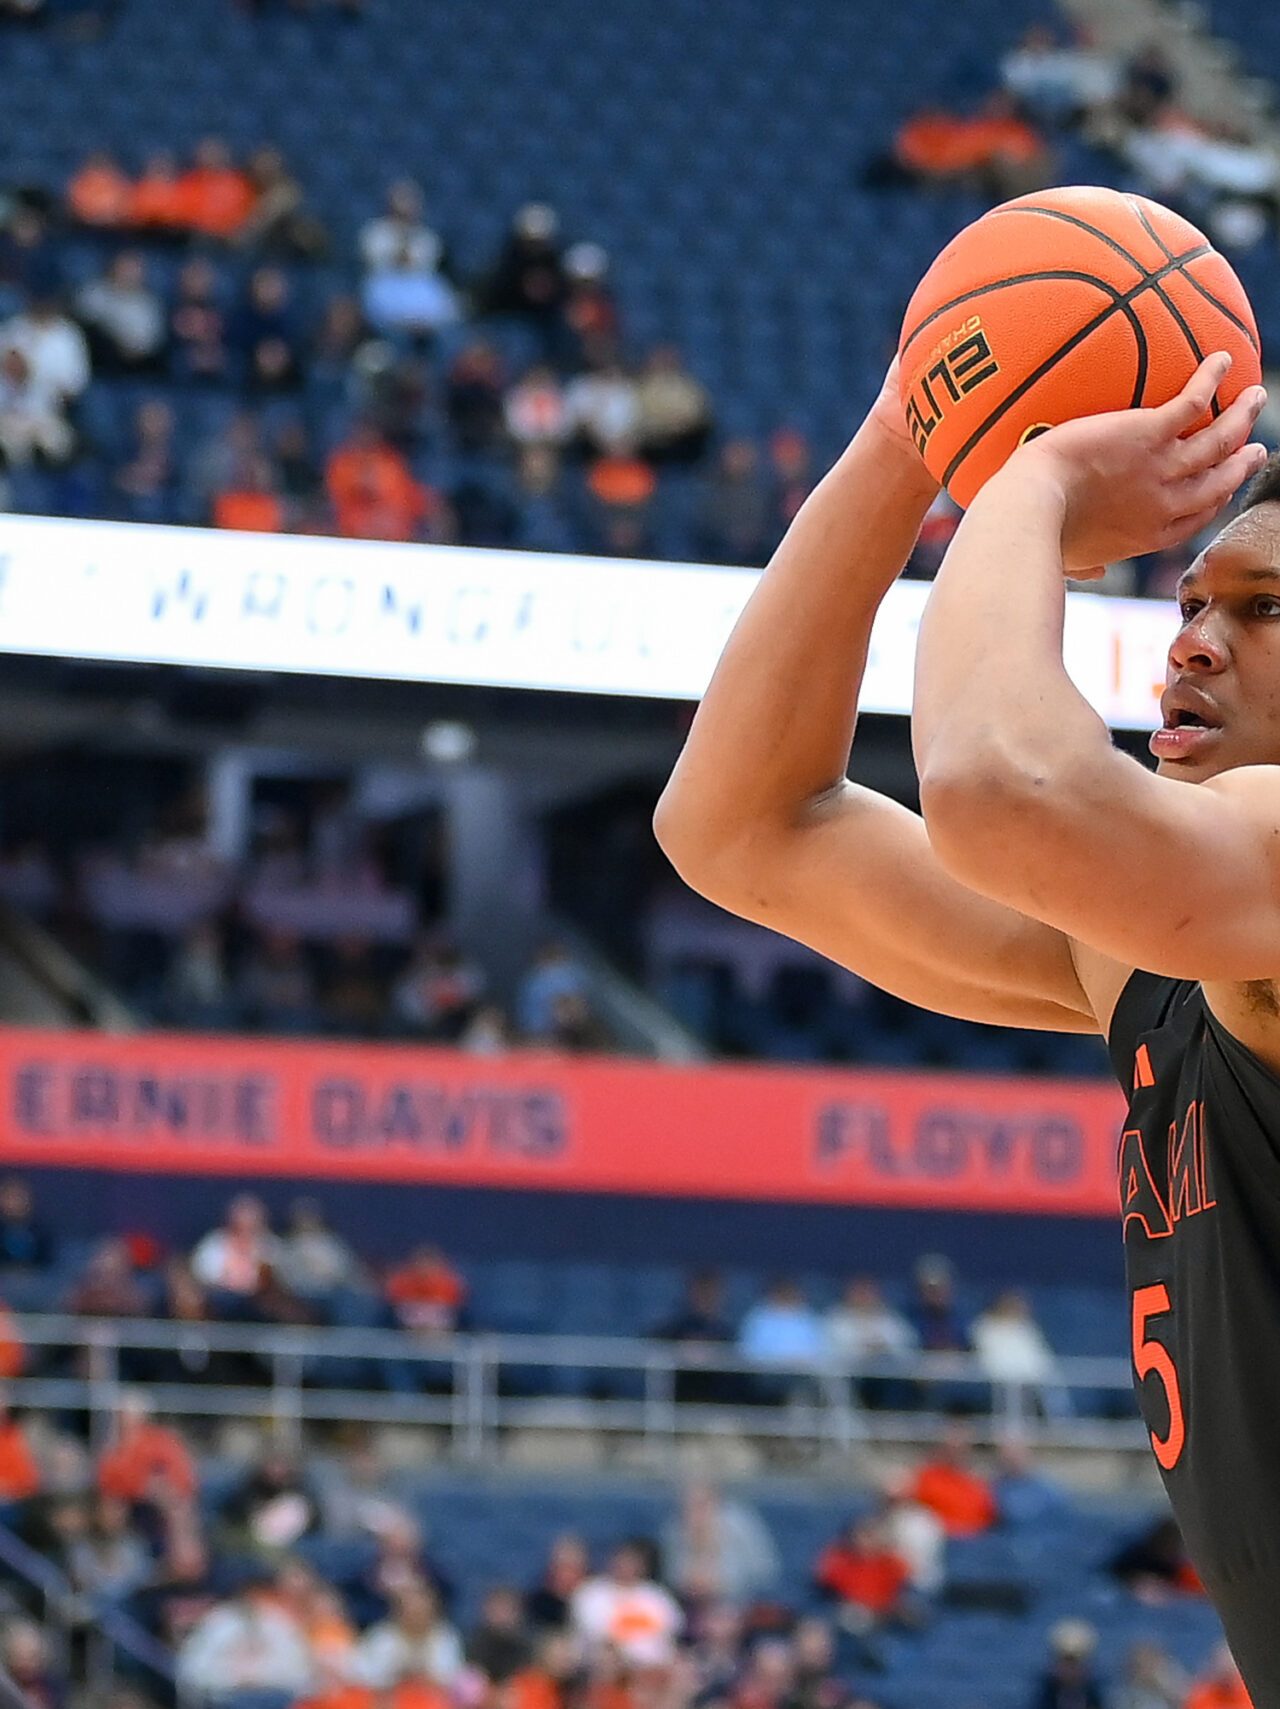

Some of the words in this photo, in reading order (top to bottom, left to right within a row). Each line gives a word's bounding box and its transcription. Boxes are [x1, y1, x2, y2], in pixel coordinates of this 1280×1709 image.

[14, 1063, 277, 1147] ERNIE
[311, 1077, 568, 1160] DAVIS
[1133, 1284, 1185, 1470] 5
